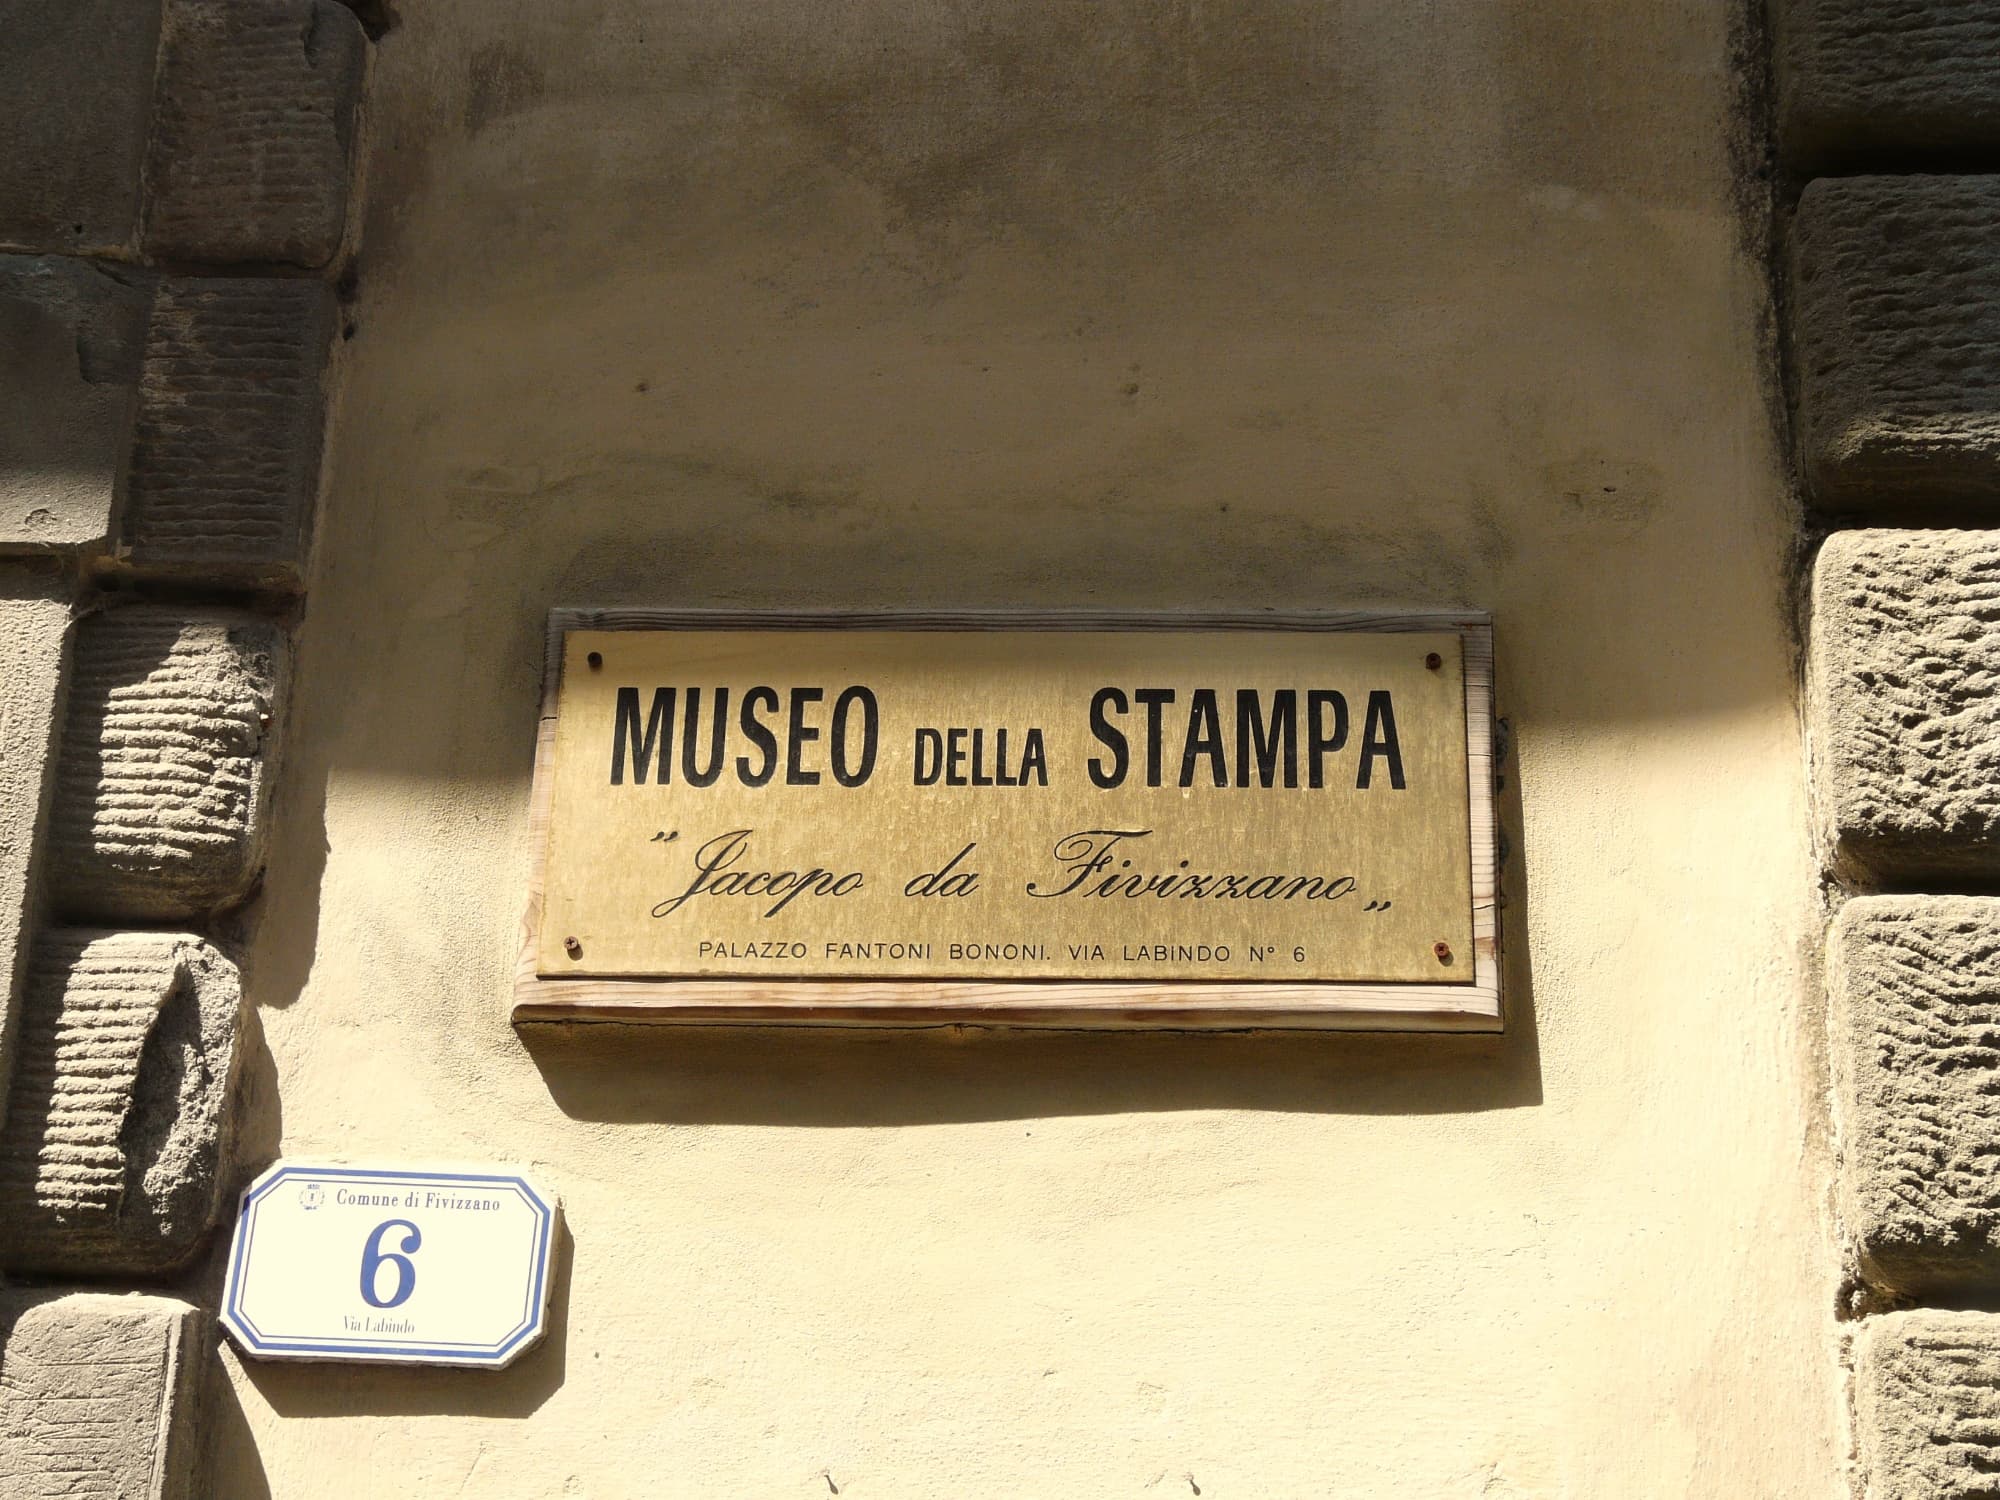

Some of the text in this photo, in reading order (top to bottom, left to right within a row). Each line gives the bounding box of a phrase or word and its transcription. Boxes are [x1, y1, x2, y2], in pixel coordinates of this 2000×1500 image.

[611, 686, 1407, 789] MUSEO DELLA STAMPA
[904, 842, 979, 897] da
[699, 941, 807, 959] PALAZZO
[826, 943, 931, 960] FANTONI
[949, 943, 1051, 961] BONONI.
[1068, 945, 1105, 961] VIA
[1123, 945, 1230, 962] LABINDO
[1293, 946, 1306, 963] 6
[337, 1188, 501, 1211] Comune di Fivizzano
[360, 1219, 422, 1309] 6
[343, 1315, 415, 1334] Via Labindo
